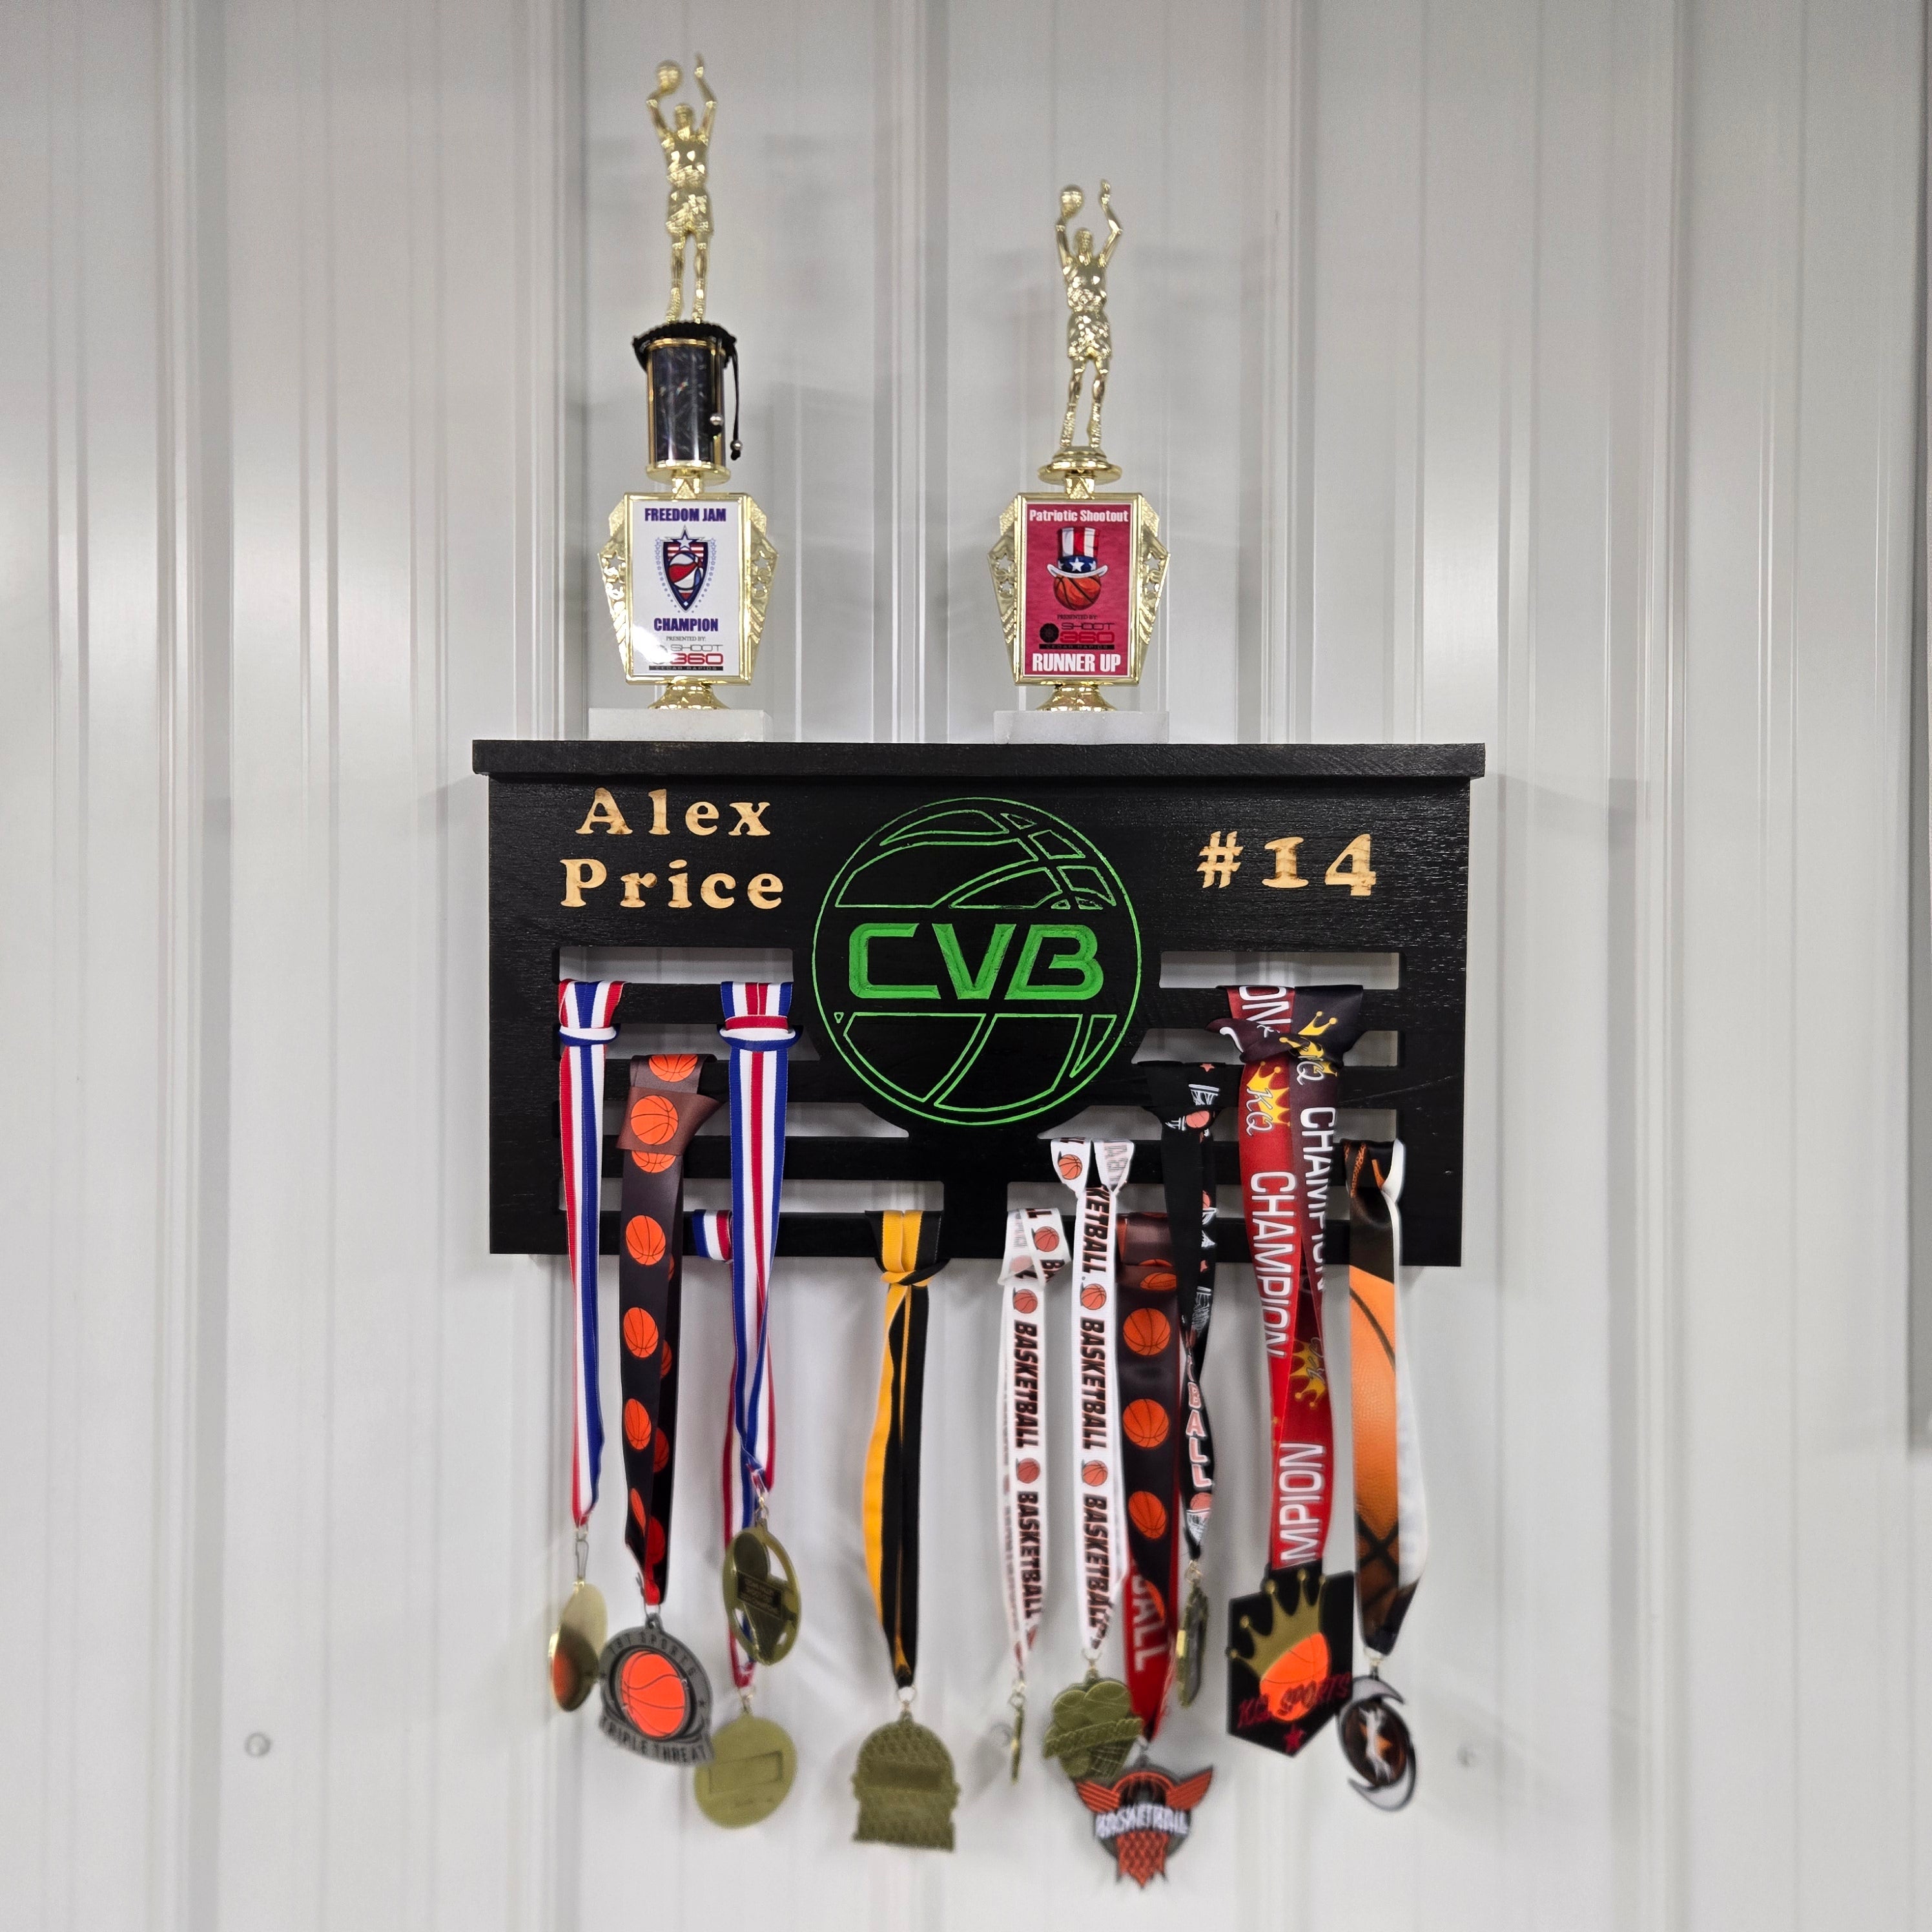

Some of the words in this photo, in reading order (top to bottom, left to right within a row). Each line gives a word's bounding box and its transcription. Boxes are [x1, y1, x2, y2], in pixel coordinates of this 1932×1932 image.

[644, 508, 700, 522] FREEDOM
[702, 508, 726, 522] JAM
[1029, 509, 1078, 522] Patriotic
[1080, 510, 1129, 522] Shootout
[653, 618, 718, 632] CHAMPION
[670, 644, 723, 652] SHOOT
[1060, 631, 1115, 644] 360
[670, 653, 723, 665] 360
[1033, 653, 1096, 672] RUNNER
[1100, 653, 1121, 672] UP
[575, 787, 771, 836] Alex
[560, 859, 783, 909] Price
[1197, 830, 1376, 896] #14
[849, 923, 1104, 1000] CVB
[1250, 1171, 1296, 1357] CHAMPION
[1013, 1319, 1040, 1449] BASKETBALL
[1080, 1317, 1107, 1450] BASKETBALL
[1017, 1490, 1042, 1619] BASKETBALL
